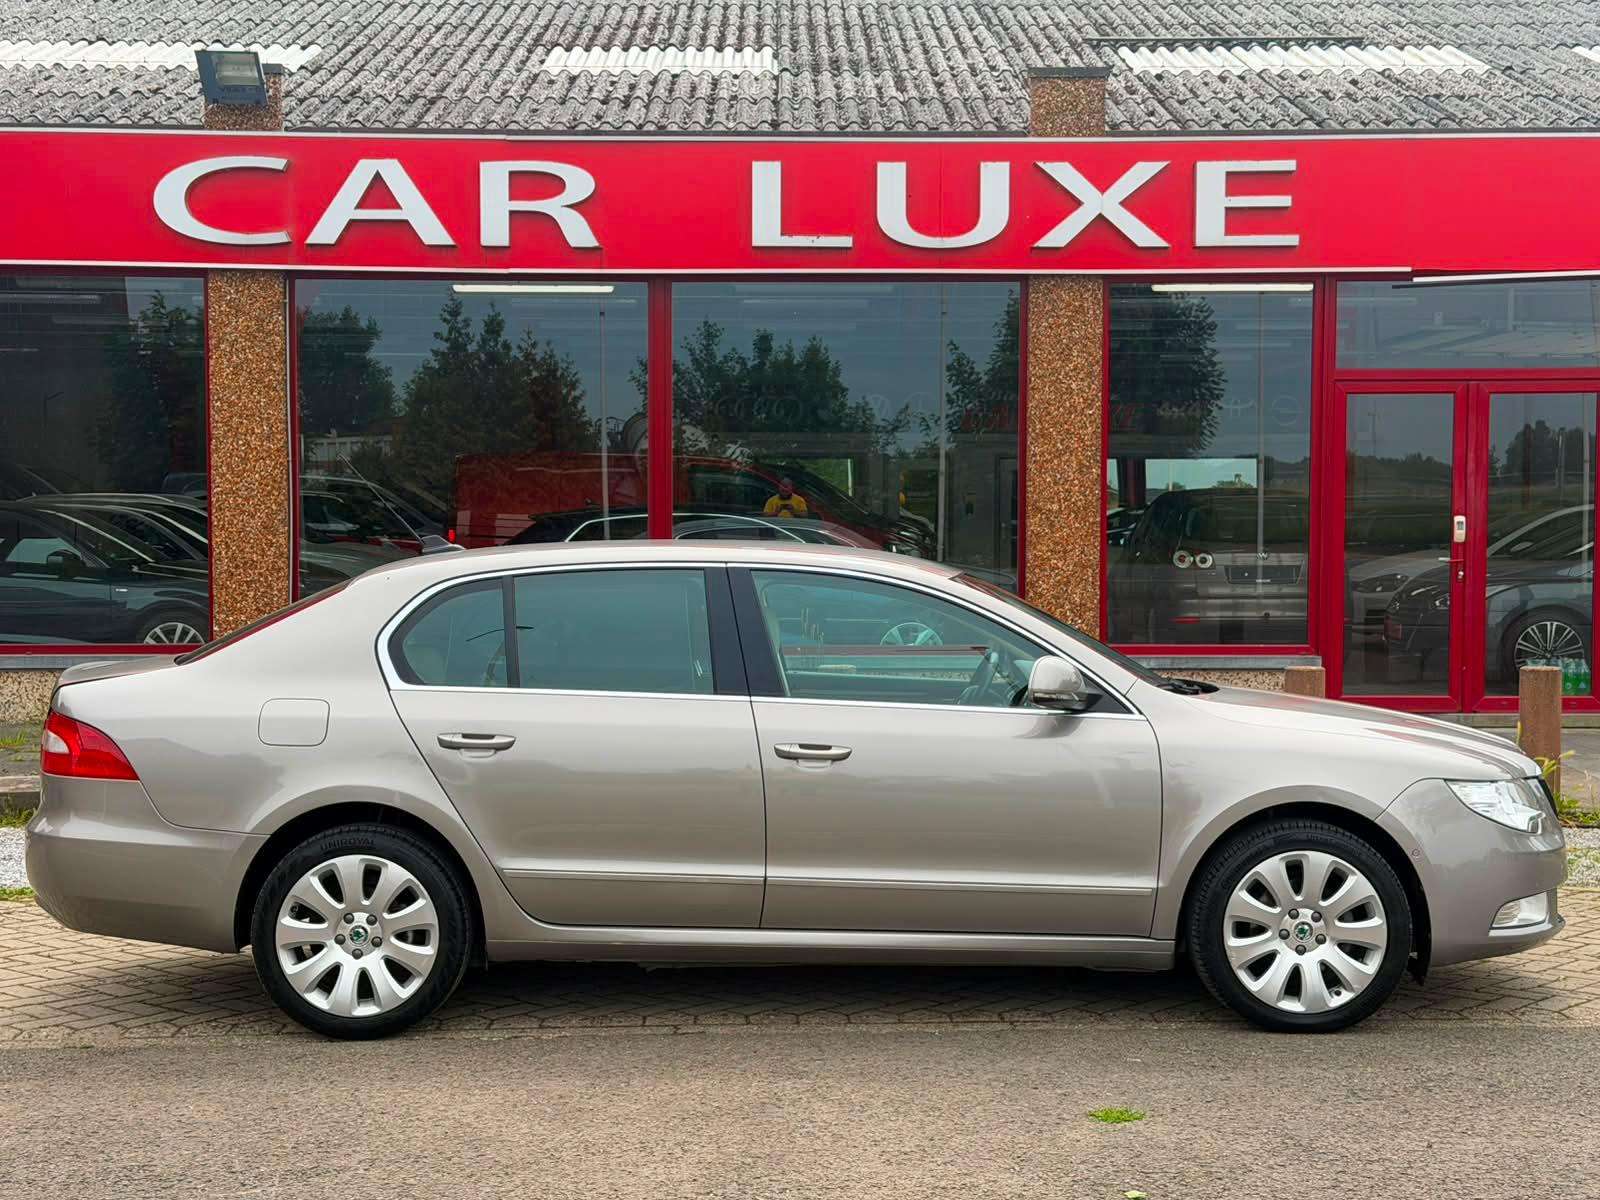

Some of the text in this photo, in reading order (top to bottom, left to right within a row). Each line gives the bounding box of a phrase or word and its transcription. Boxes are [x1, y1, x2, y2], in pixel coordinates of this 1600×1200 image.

[153, 155, 1300, 249] CAR LUXE
[319, 837, 376, 850] UNIROYAL
